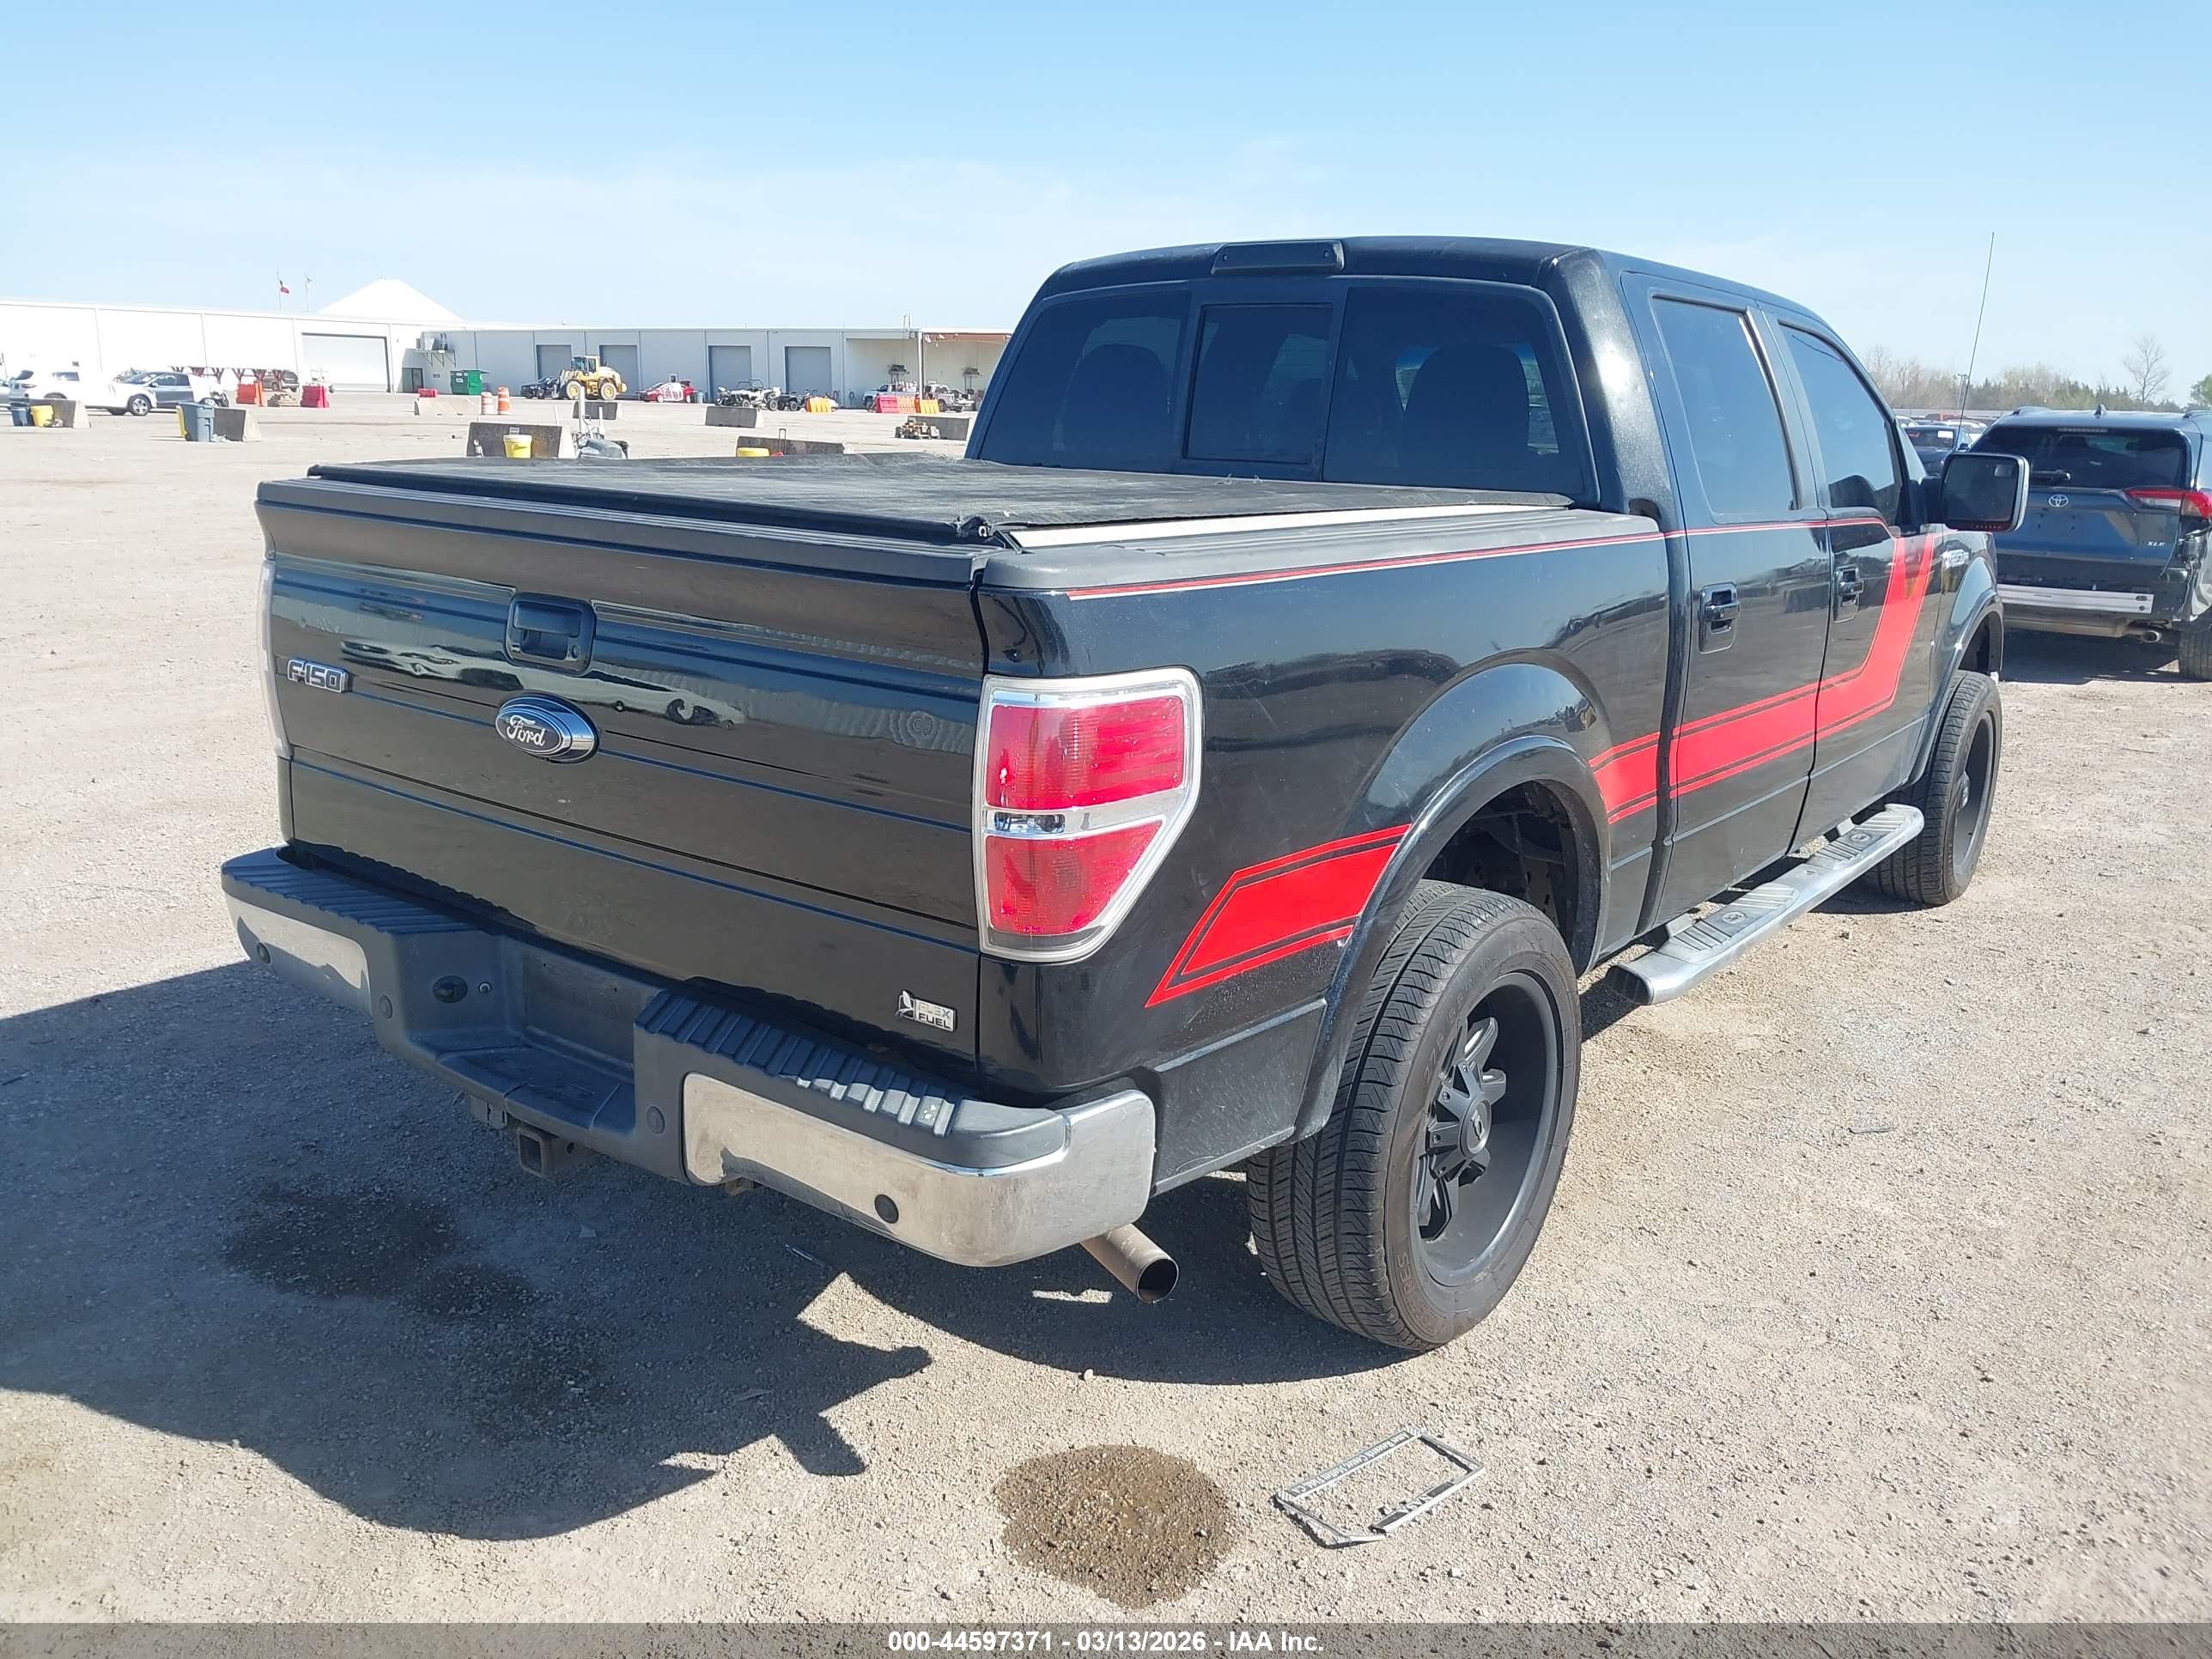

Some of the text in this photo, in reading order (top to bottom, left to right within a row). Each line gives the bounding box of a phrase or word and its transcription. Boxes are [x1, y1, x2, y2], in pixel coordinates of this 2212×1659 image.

[287, 659, 344, 694] F-150
[506, 714, 547, 747] Ford
[918, 1001, 951, 1019] FLEX
[918, 1012, 951, 1030] FUEL
[1401, 1493, 1434, 1513] NASA
